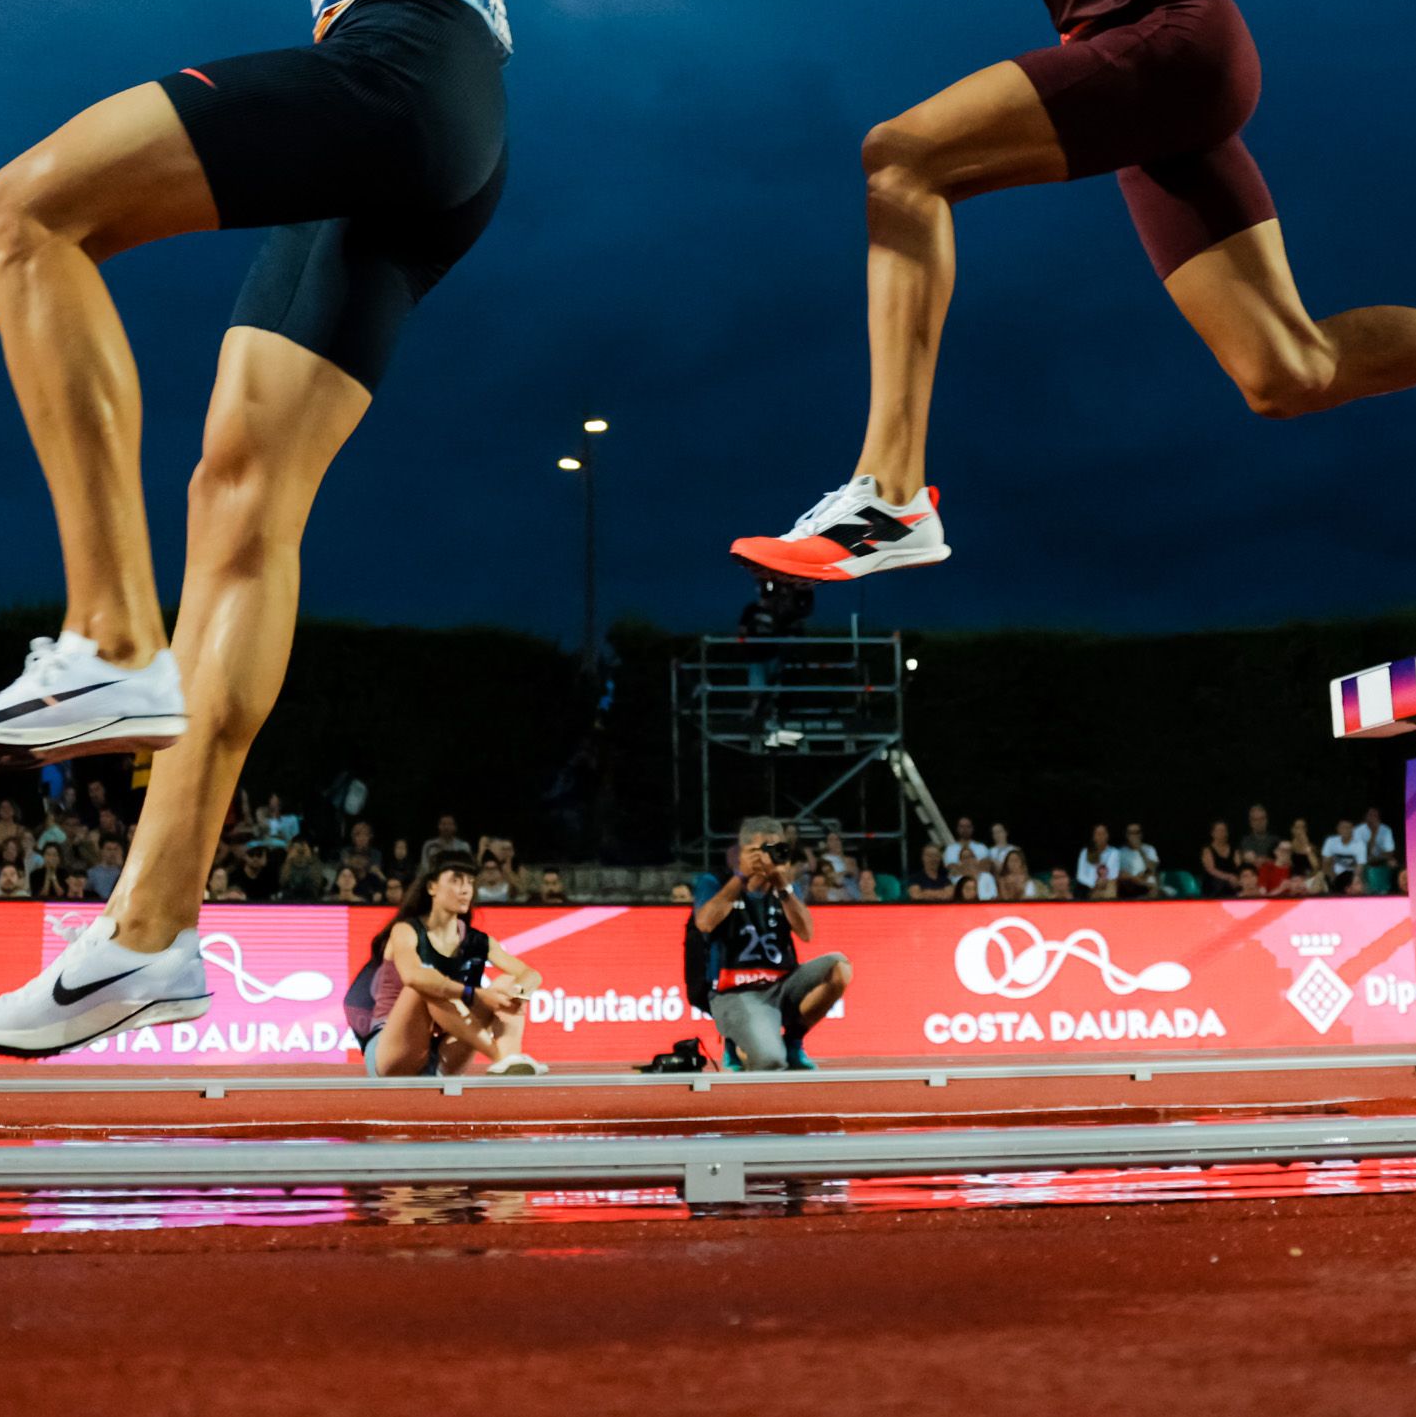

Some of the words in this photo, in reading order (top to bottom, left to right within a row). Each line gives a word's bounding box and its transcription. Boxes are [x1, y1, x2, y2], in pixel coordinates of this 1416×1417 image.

[738, 924, 782, 964] 26
[529, 986, 683, 1031] Diputació
[925, 1014, 1043, 1042] COSTA
[1051, 1010, 1224, 1040] DAURADA
